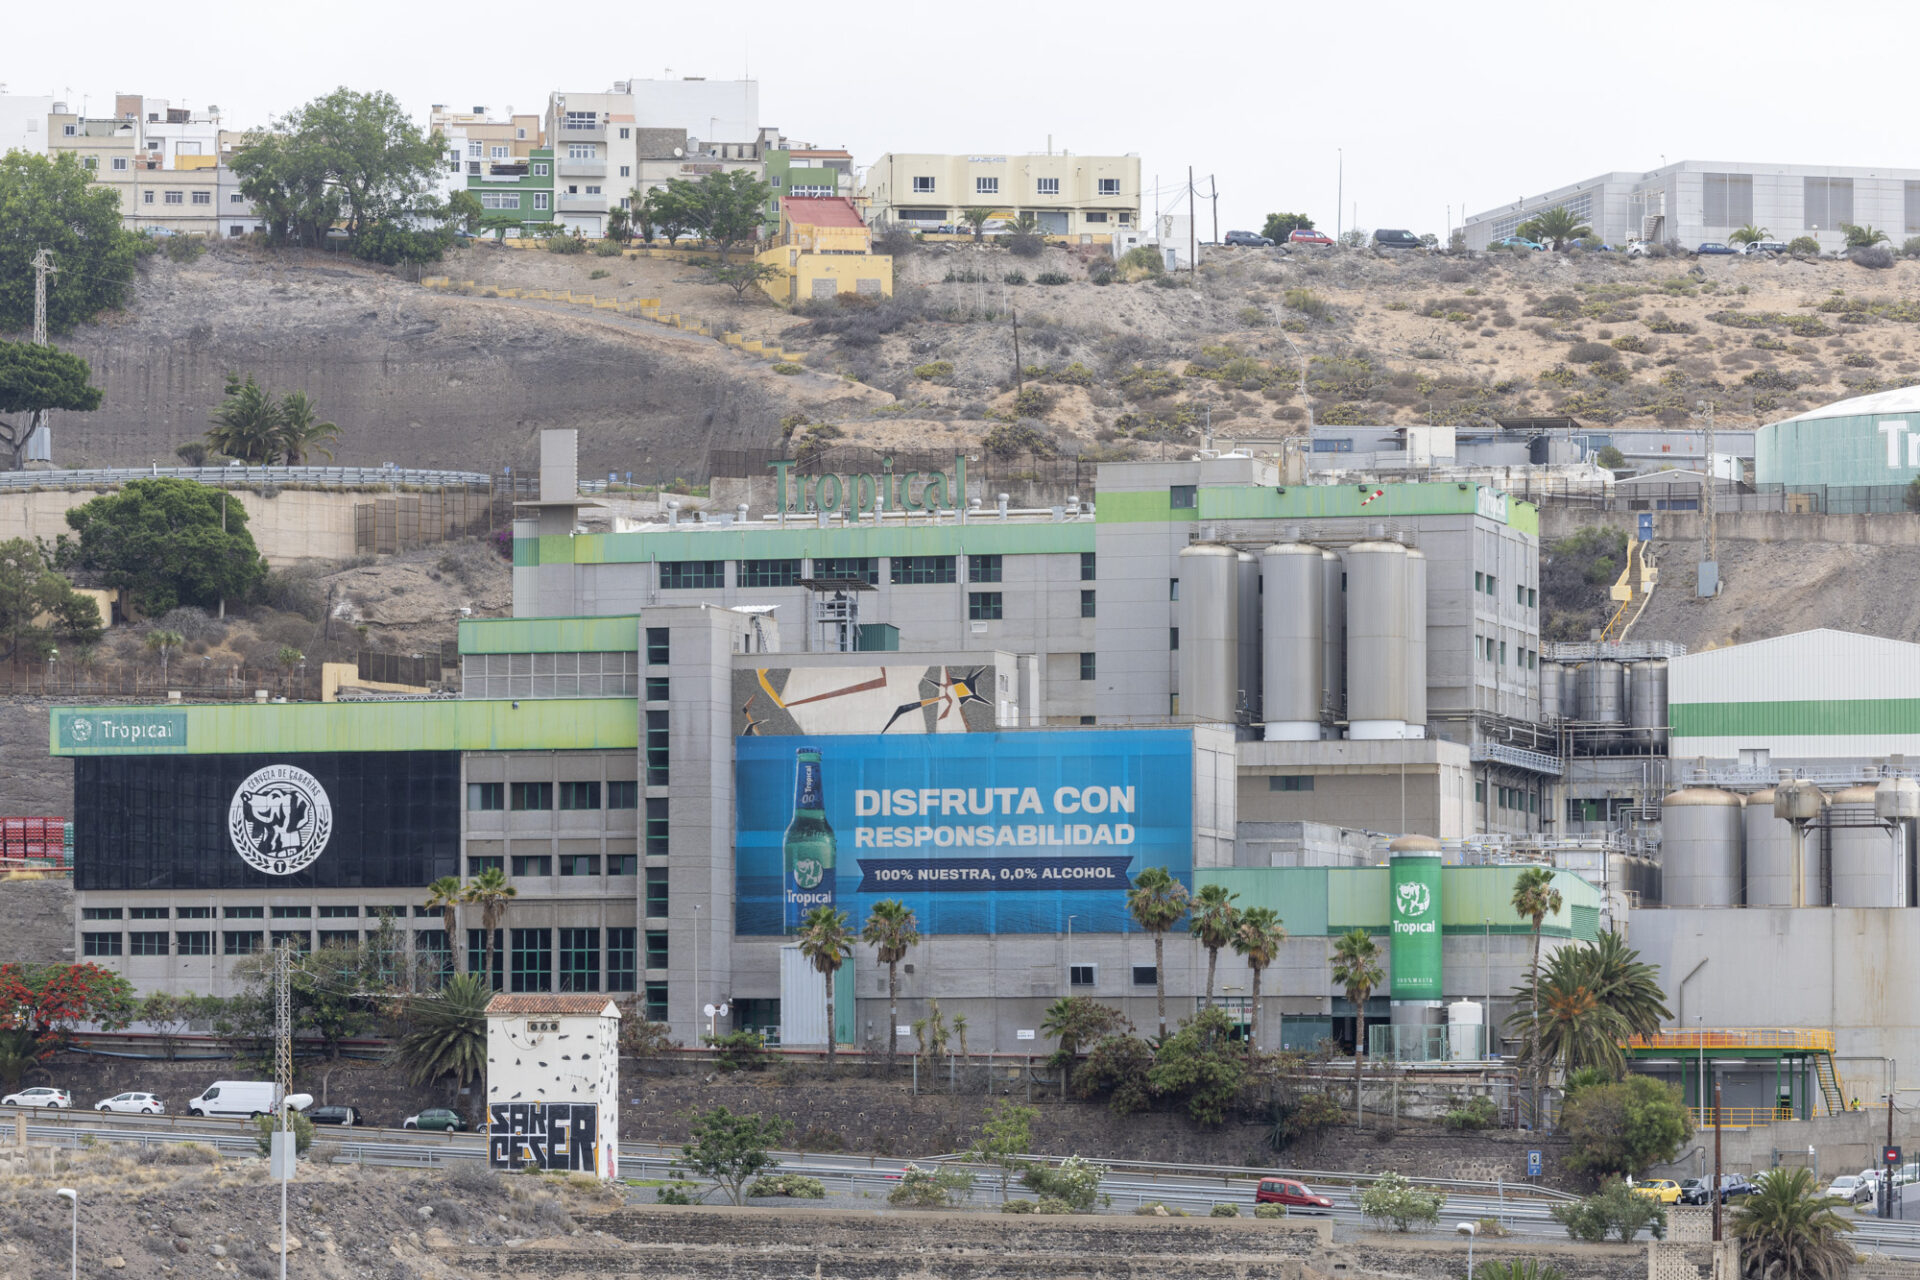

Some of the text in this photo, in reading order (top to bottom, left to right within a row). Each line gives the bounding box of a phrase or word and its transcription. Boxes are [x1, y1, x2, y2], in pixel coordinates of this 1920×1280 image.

[767, 455, 967, 523] Tropical
[247, 769, 275, 790] CERVEZA
[278, 768, 287, 778] DE
[804, 765, 813, 793] Tropical
[855, 786, 1135, 816] DISFRUTA CON
[855, 823, 1135, 848] RESPONSABILIDAD
[874, 867, 1116, 881] 100% NUESTRA, 0,0% ALCOHOL
[787, 889, 832, 907] Tropical
[1393, 920, 1435, 935] Tropical
